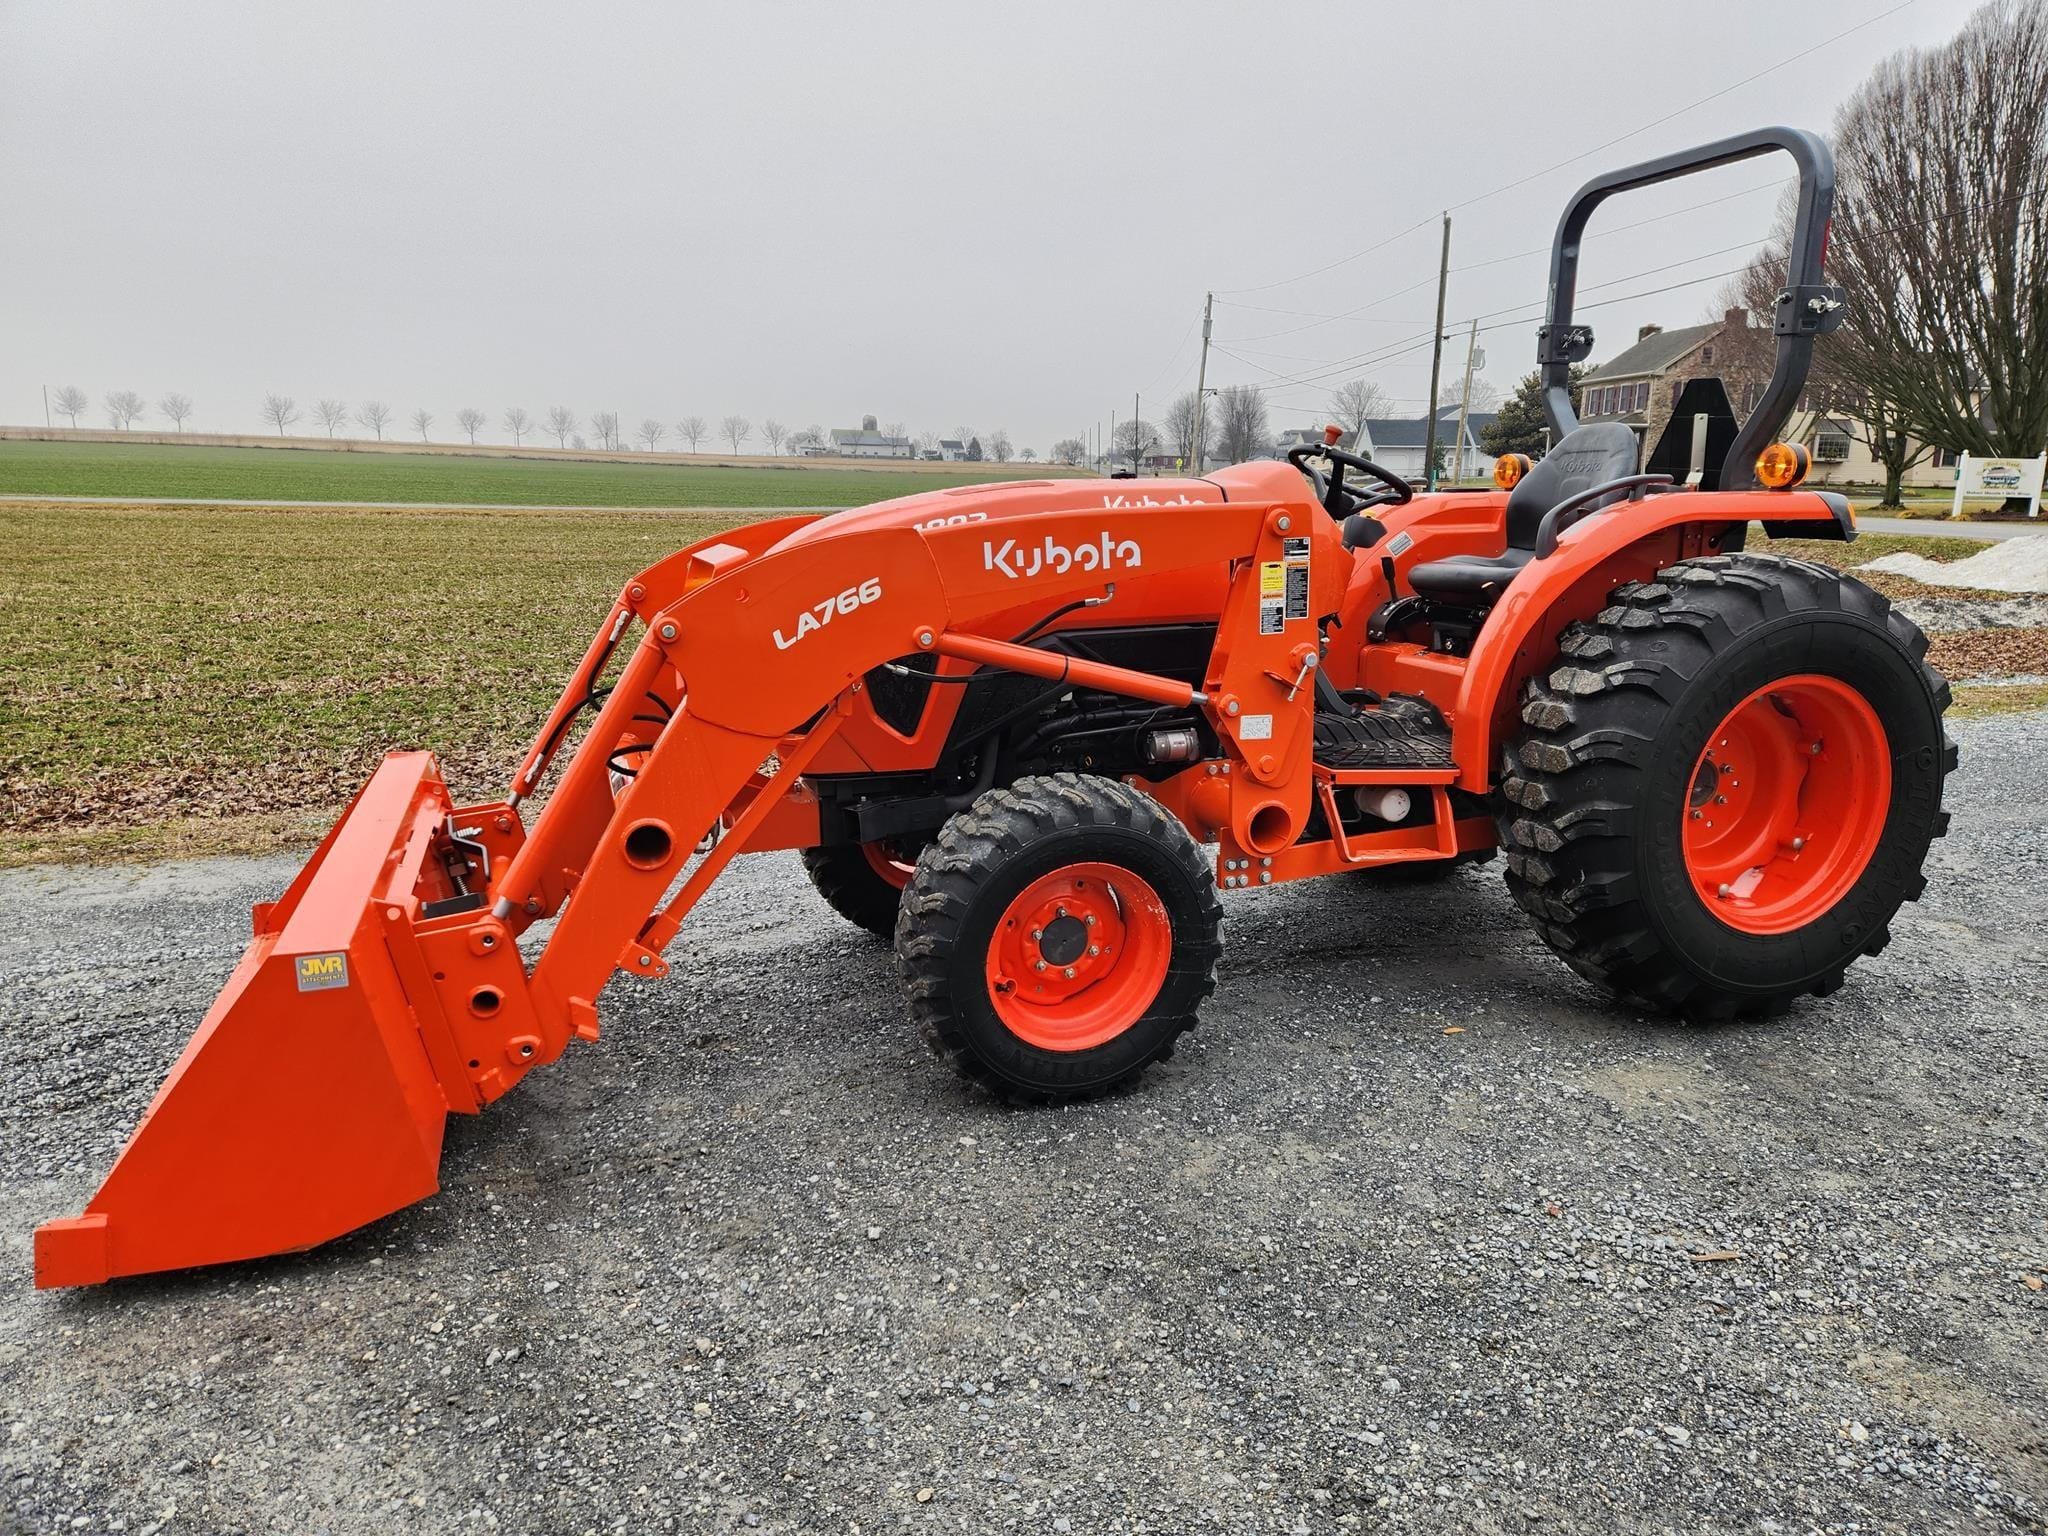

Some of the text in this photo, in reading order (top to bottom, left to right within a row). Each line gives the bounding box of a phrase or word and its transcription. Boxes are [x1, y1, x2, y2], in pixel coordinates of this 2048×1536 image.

[1103, 494, 1206, 509] Kbt
[983, 531, 1141, 578] Kubota
[773, 577, 882, 650] LA766
[301, 956, 343, 976] JMR
